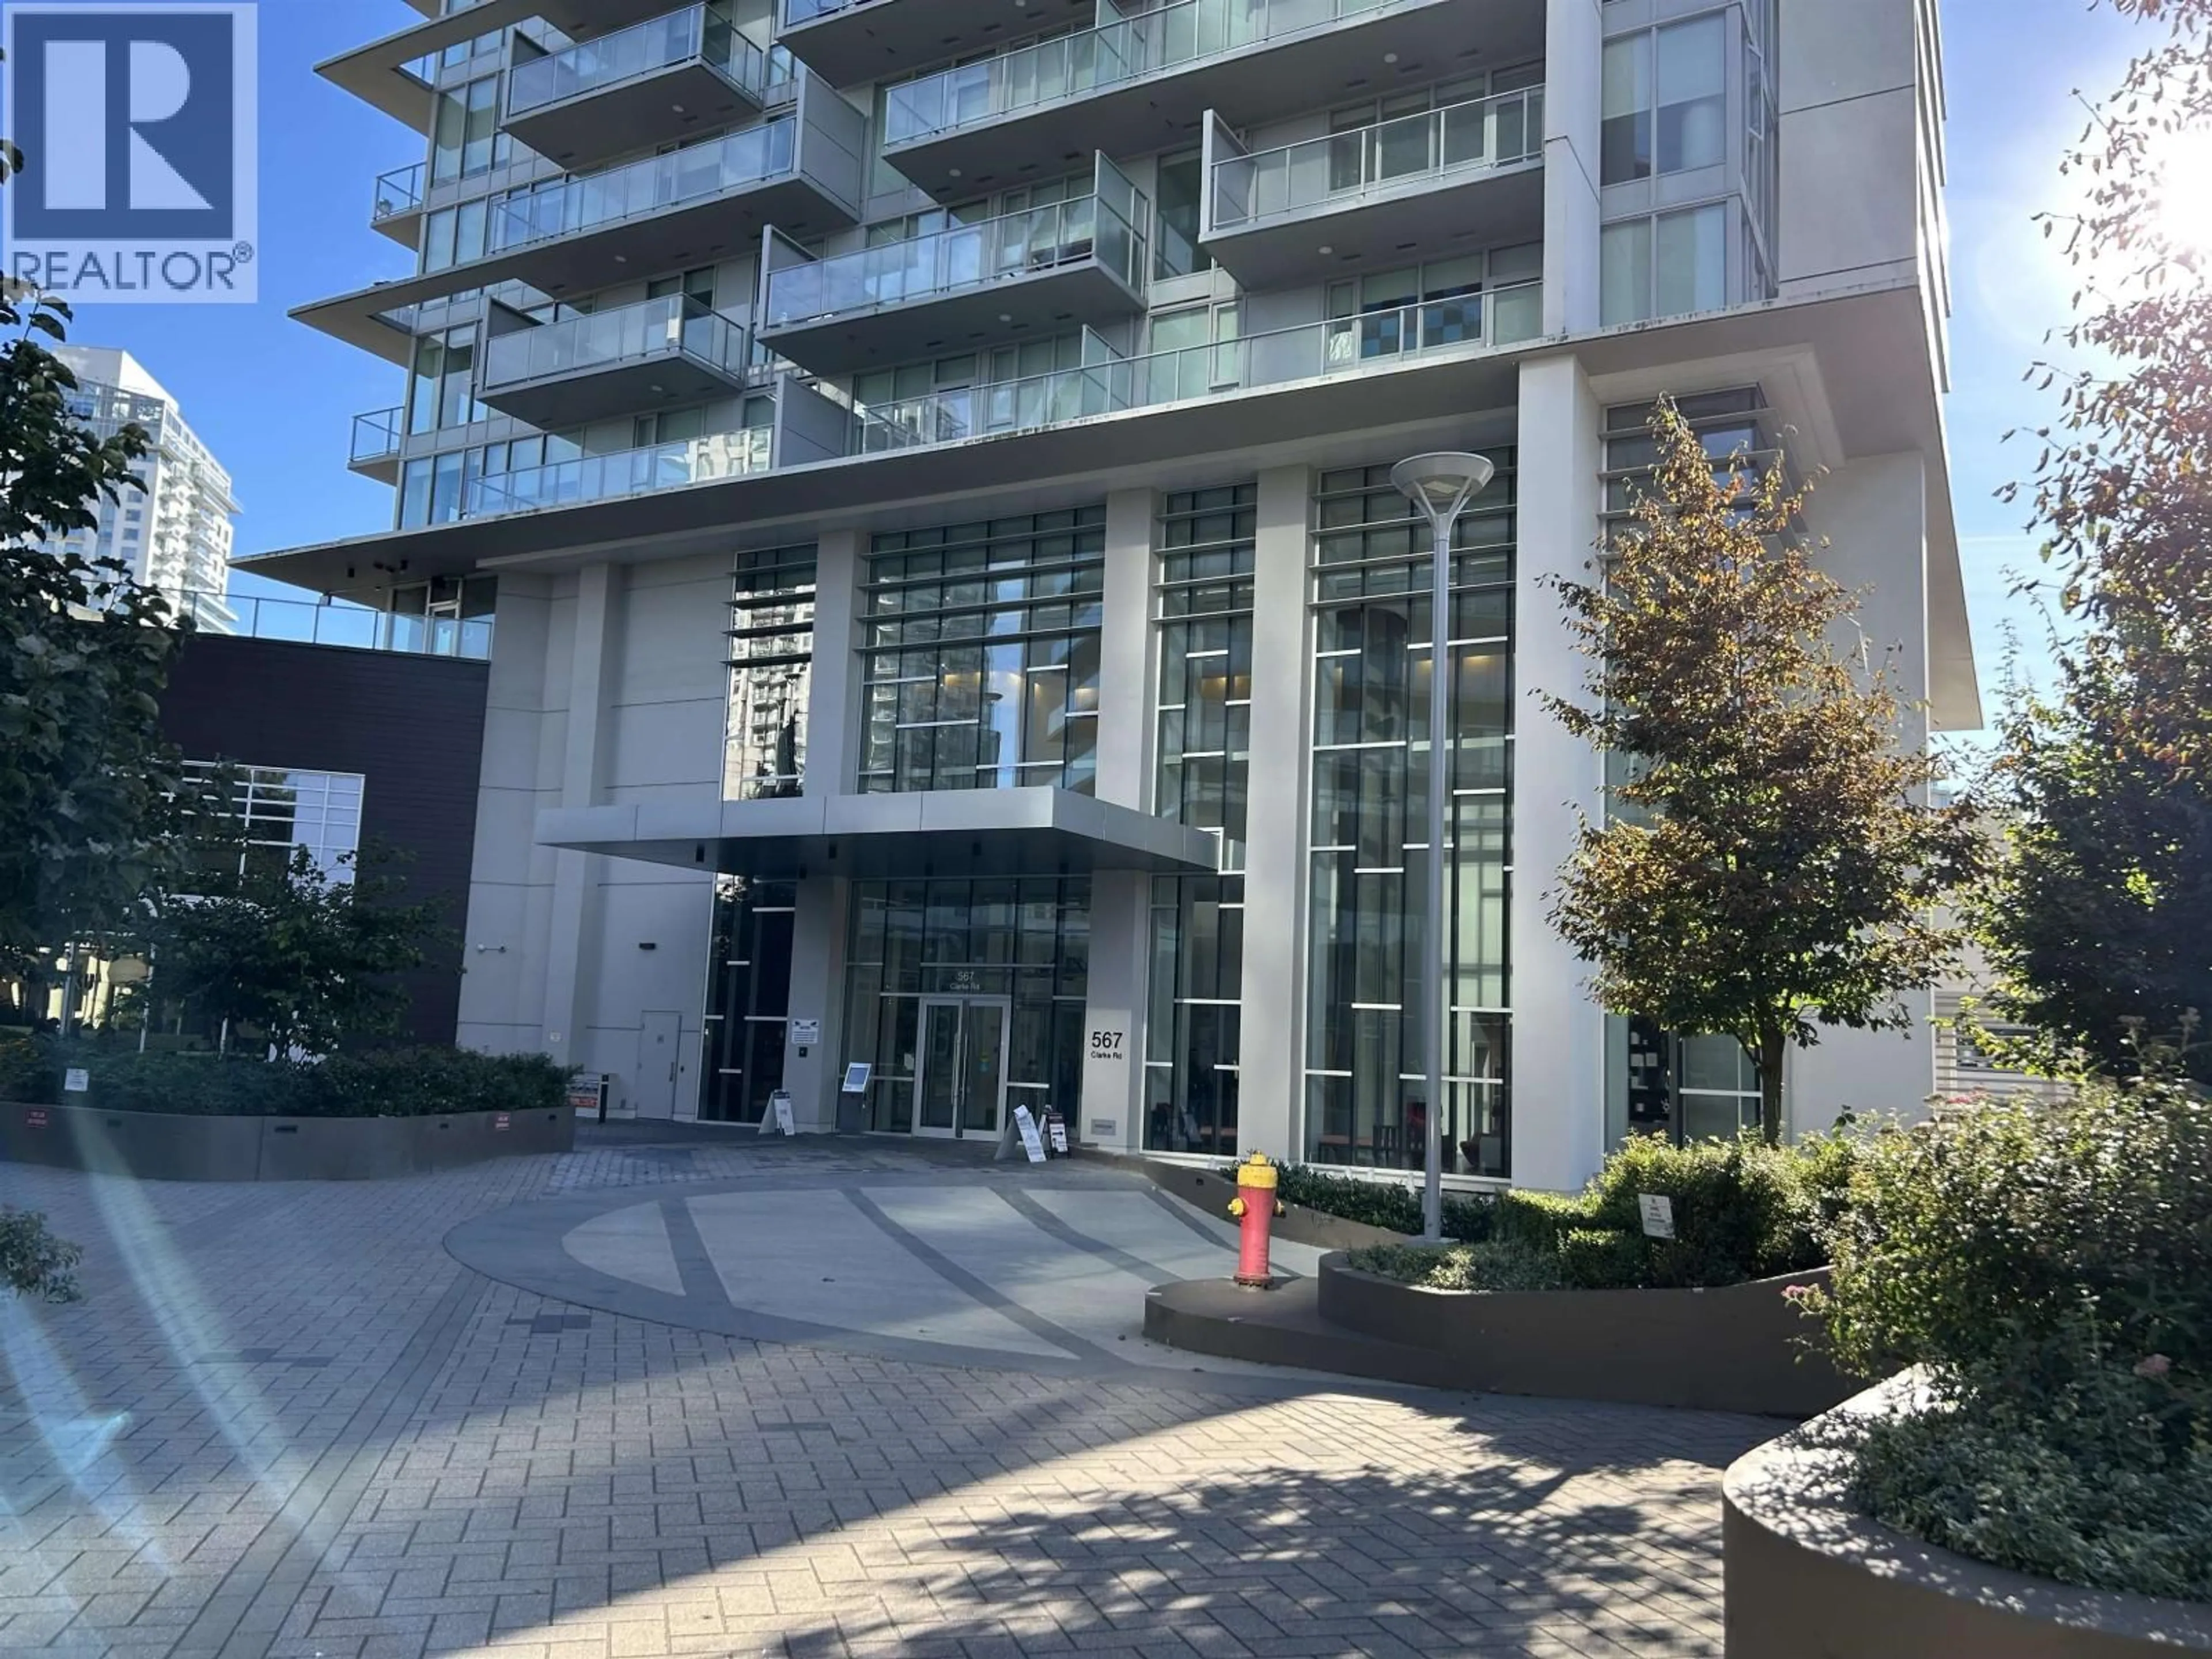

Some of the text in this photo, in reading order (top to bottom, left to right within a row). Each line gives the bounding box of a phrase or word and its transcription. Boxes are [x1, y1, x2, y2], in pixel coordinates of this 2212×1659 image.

[957, 971, 974, 982] 567
[1092, 1031, 1123, 1048] 567
[1112, 1051, 1122, 1060] Rd
